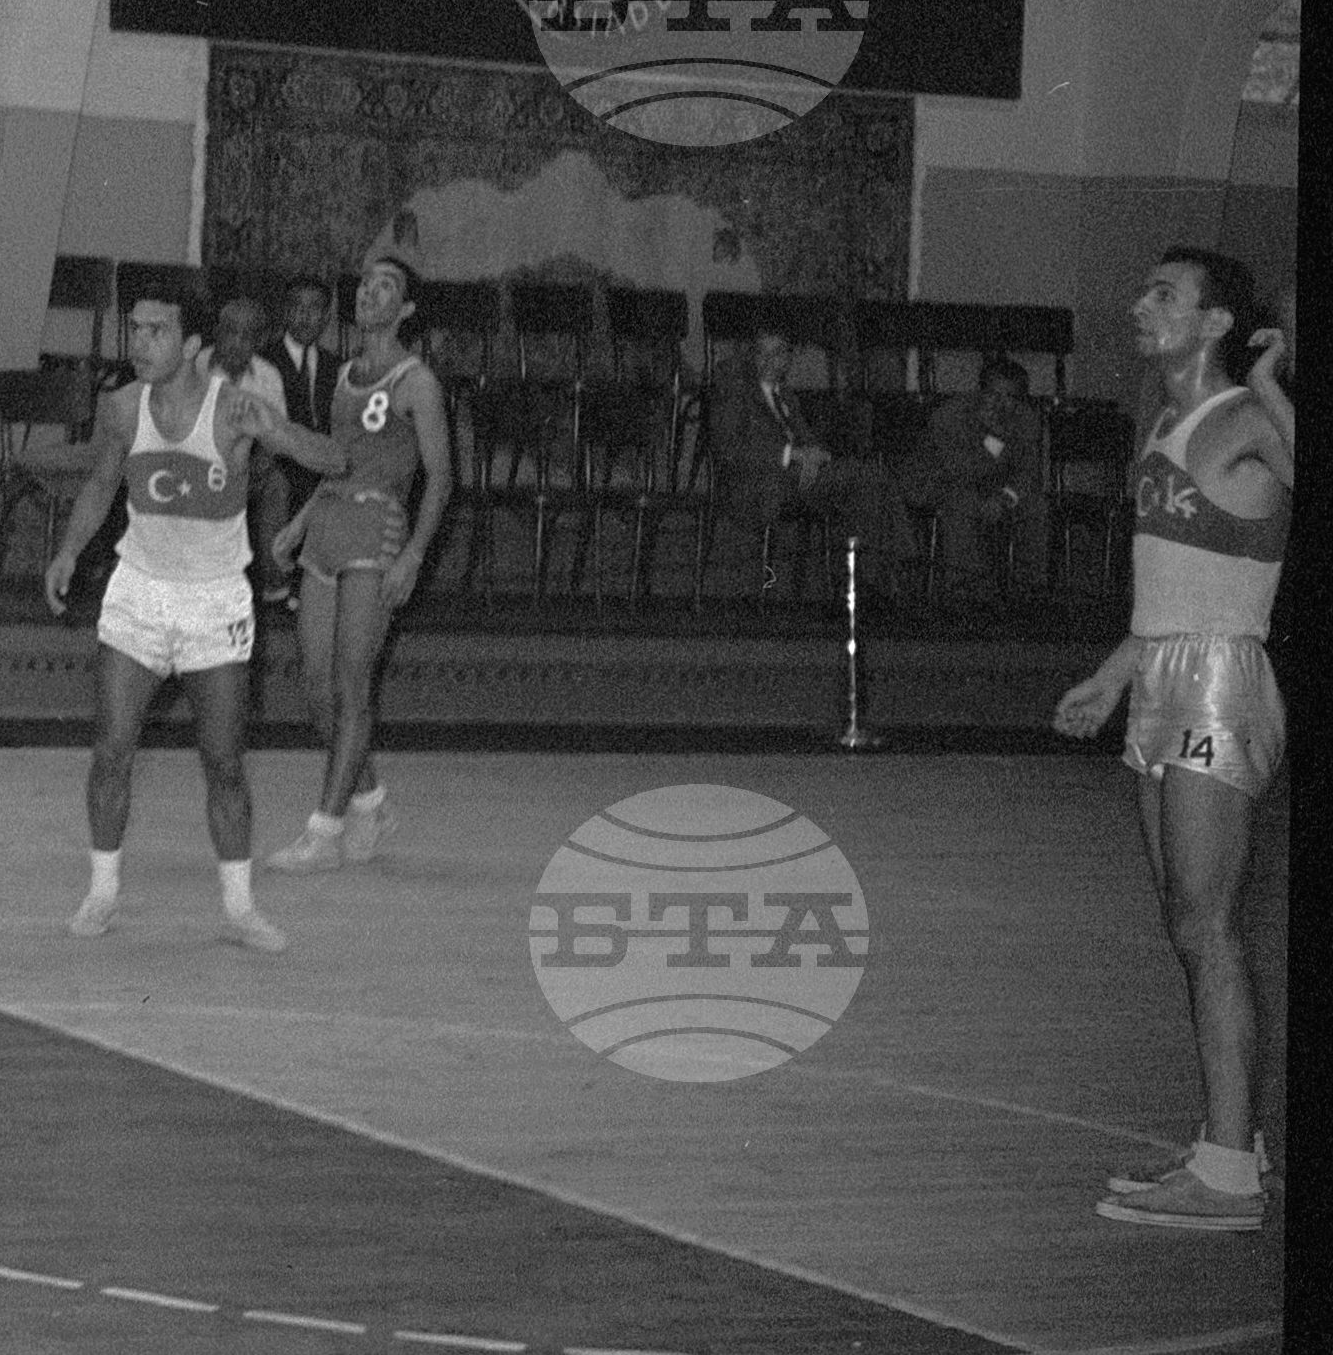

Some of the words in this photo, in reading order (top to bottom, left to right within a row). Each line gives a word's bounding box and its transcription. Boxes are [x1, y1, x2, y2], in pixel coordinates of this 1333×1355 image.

[361, 390, 389, 433] 8
[1165, 474, 1198, 520] 14
[1178, 729, 1214, 767] 14
